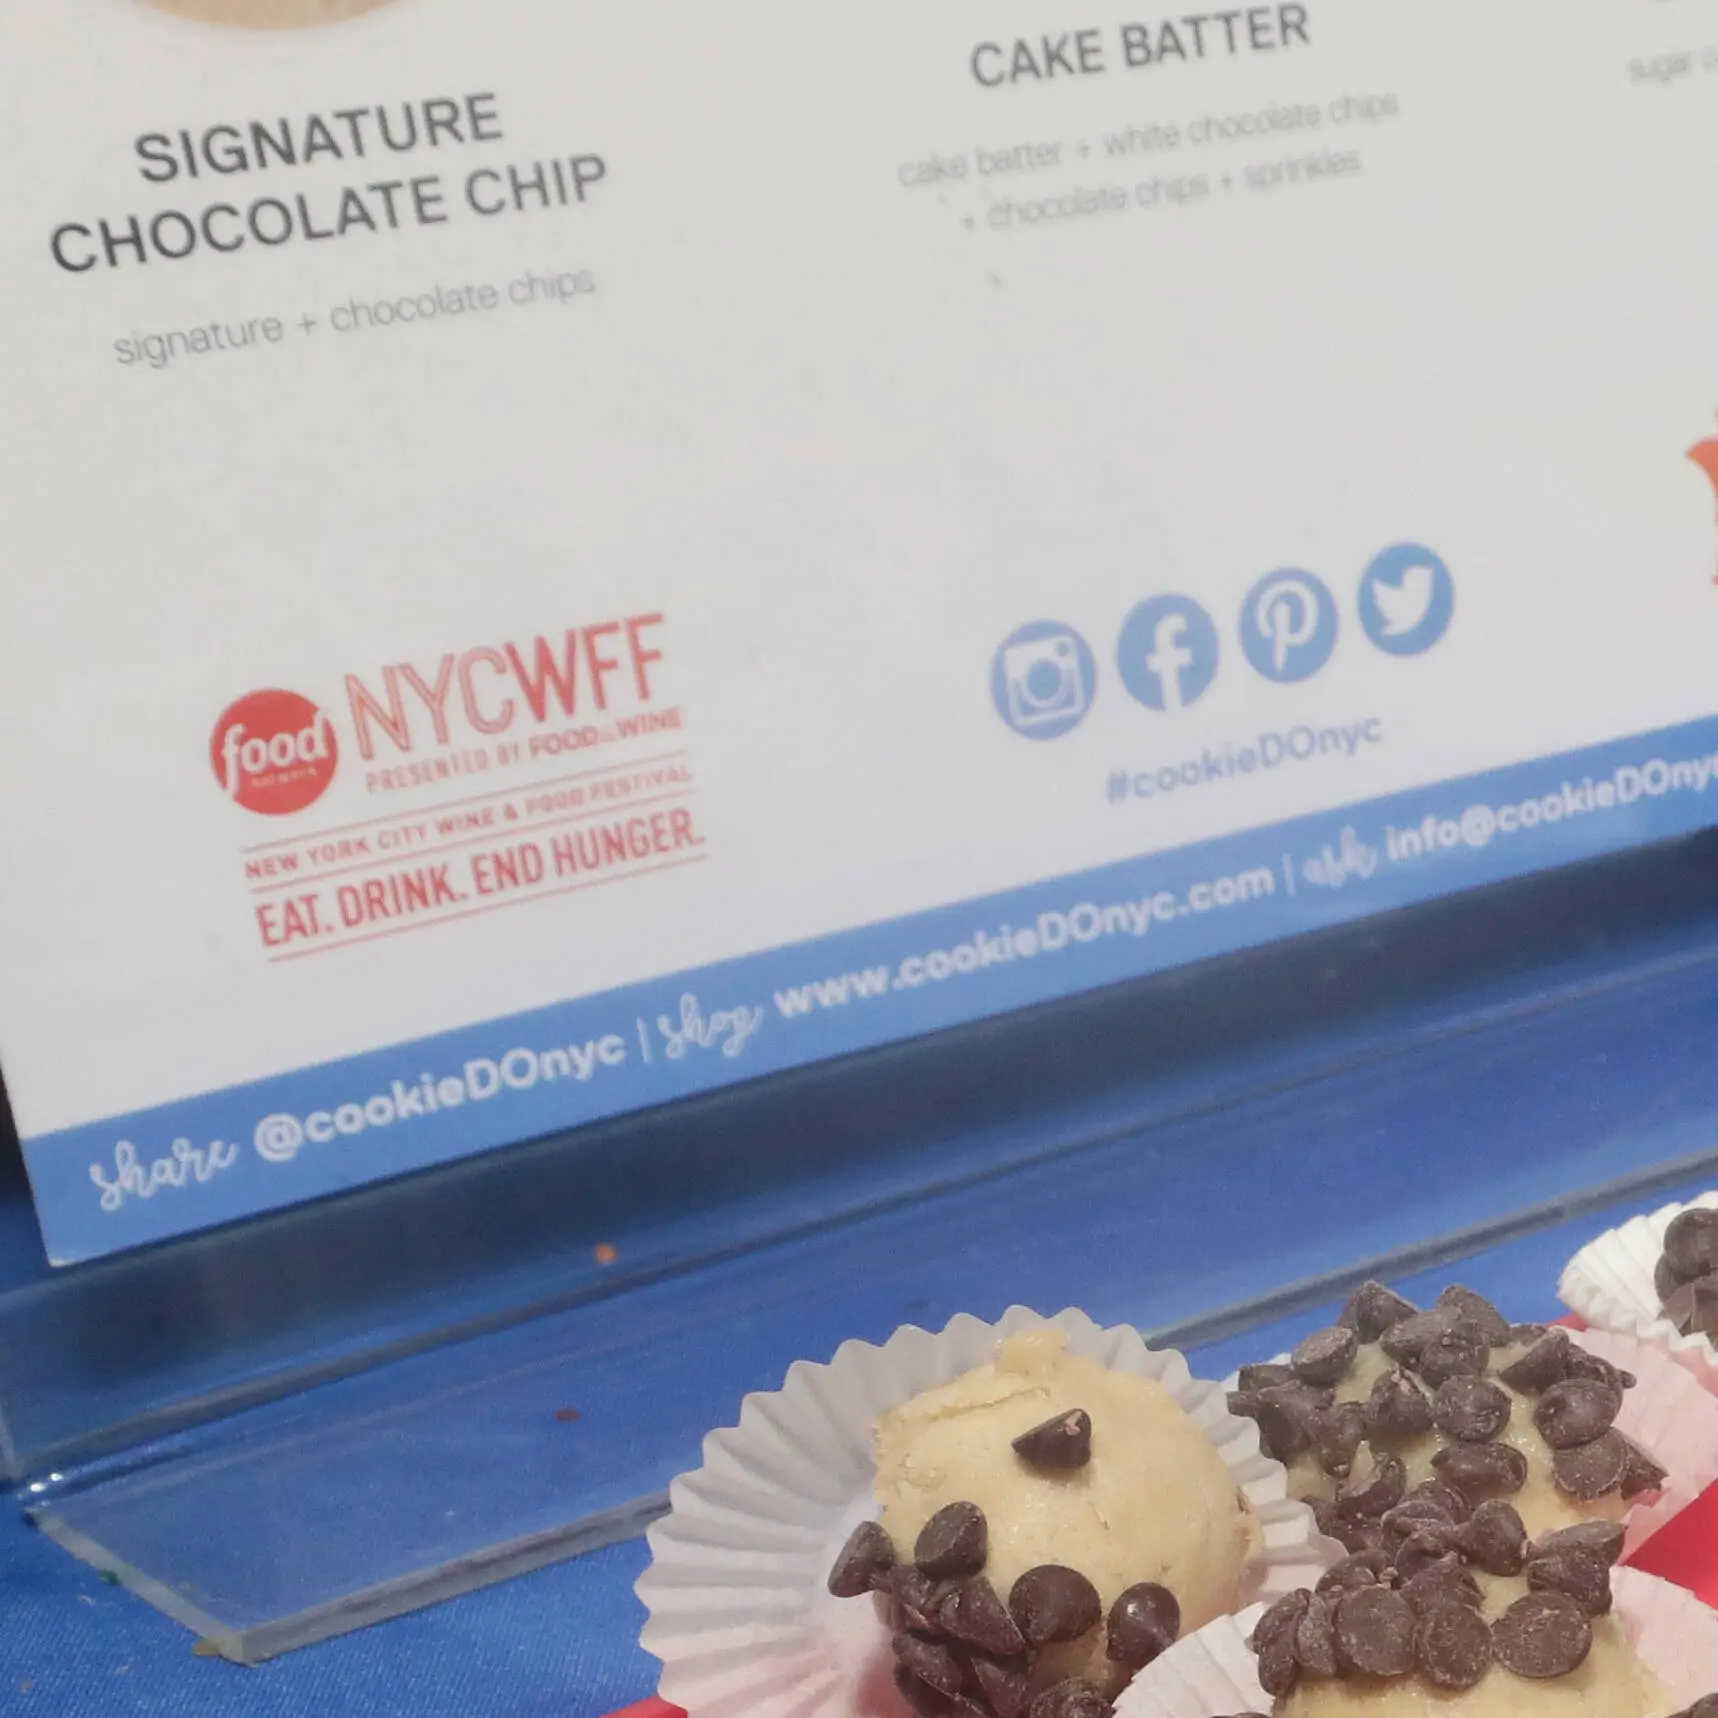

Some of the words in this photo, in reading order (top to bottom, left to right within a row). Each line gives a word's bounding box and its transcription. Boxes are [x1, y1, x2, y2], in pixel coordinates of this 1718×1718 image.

[972, 29, 1105, 88] CAKE
[1120, 2, 1311, 69] BATTER
[135, 92, 503, 183] SIGNATURE
[898, 149, 968, 189] cake
[976, 139, 1063, 178] batter
[1101, 120, 1181, 157] white
[1187, 103, 1321, 144] chocolate
[1328, 89, 1399, 124] chips
[51, 175, 448, 272] CHOCOLATE
[465, 154, 608, 216] CHIP
[985, 187, 1128, 231] chocolate
[1135, 171, 1210, 211] chips
[1243, 148, 1362, 190] sprinkles
[114, 312, 284, 369] signature
[298, 314, 318, 338] +
[330, 281, 499, 334] chocolate
[507, 267, 596, 307] chips
[343, 611, 665, 762] NYCWFF
[221, 708, 329, 800] food
[366, 748, 489, 793] PRESENTED
[497, 743, 519, 766] BY
[529, 725, 600, 759] FOOD
[615, 706, 684, 739] WINE
[1106, 717, 1383, 804] #cookieDOnyc
[244, 854, 298, 879] NEW
[307, 836, 371, 864] YORK
[377, 825, 427, 850] CITY
[434, 807, 495, 837] WINE
[503, 802, 519, 821] &
[525, 788, 586, 815] FOOD
[589, 764, 692, 799] FESTIVAL
[255, 895, 334, 947] EAT.
[336, 861, 469, 928] DRINK.
[470, 843, 545, 896] END
[551, 808, 706, 877] HUNGER.
[90, 1138, 238, 1211] share
[253, 1032, 625, 1163] @cookieDOnyc
[773, 869, 1275, 1018] www.cookieDOnyc.com
